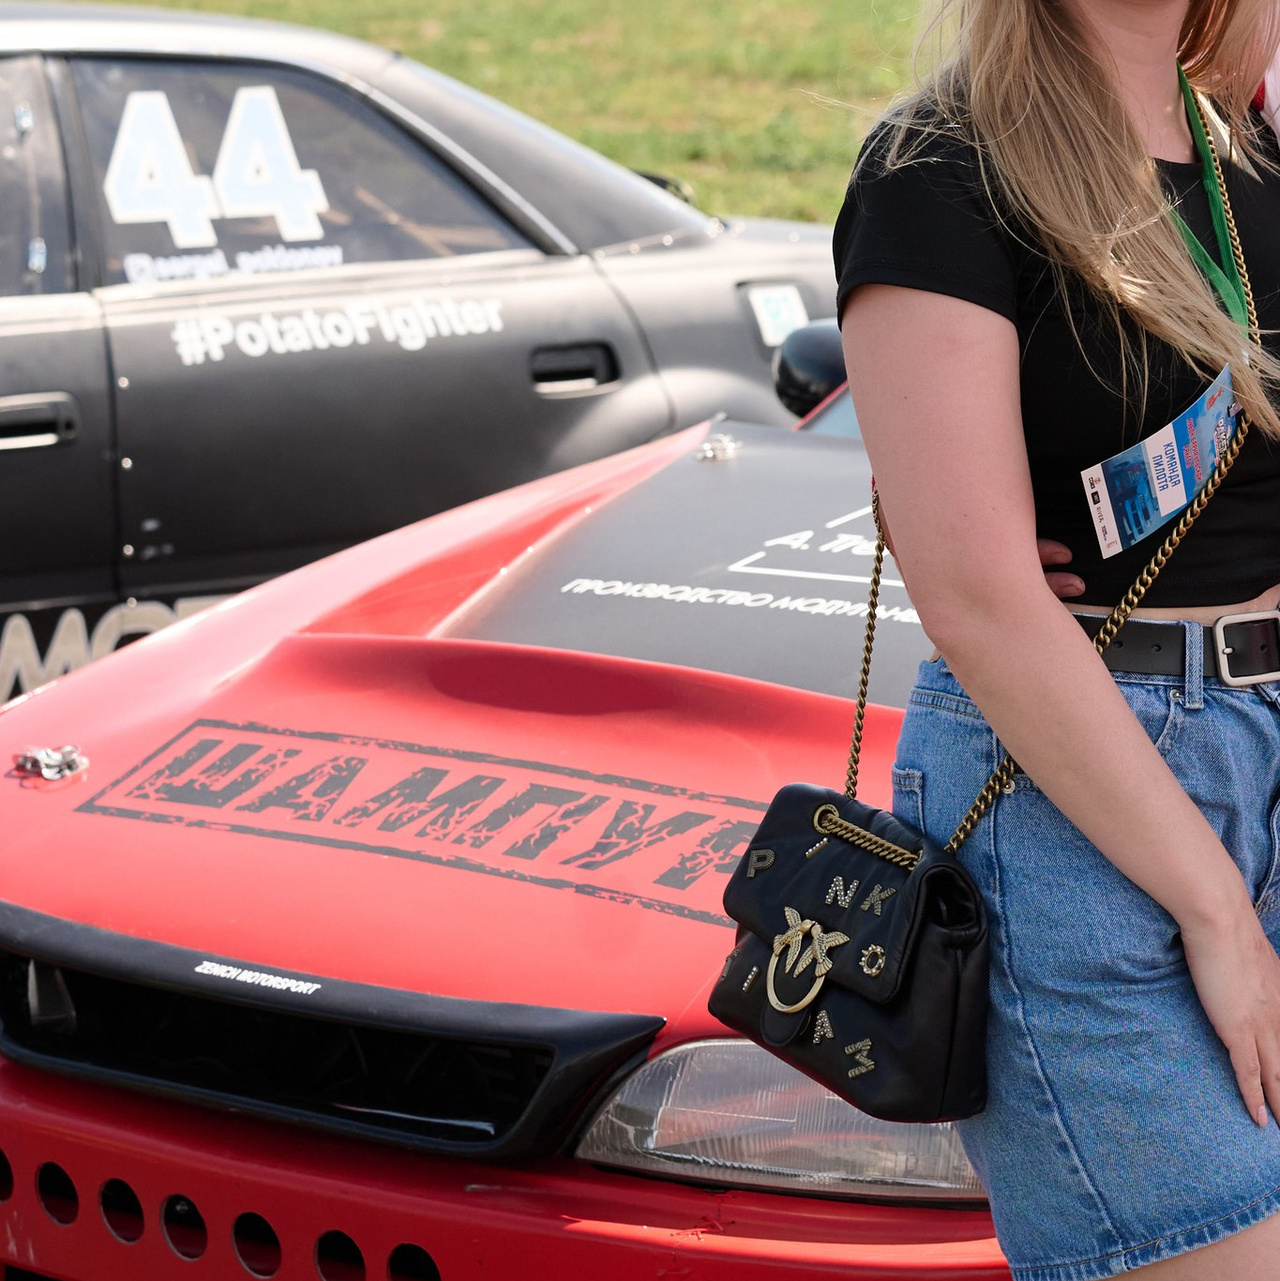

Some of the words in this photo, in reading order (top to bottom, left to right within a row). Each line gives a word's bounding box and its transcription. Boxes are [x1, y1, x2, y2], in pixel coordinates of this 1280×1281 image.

[103, 85, 330, 248] 44
[170, 298, 504, 366] #PotatoFighter
[1152, 454, 1169, 492] ПИЛОТА
[1163, 441, 1181, 488] КОМАНДА
[560, 577, 774, 608] ПРОИЗВОДСТВО
[236, 969, 322, 995] MOTORSPORT
